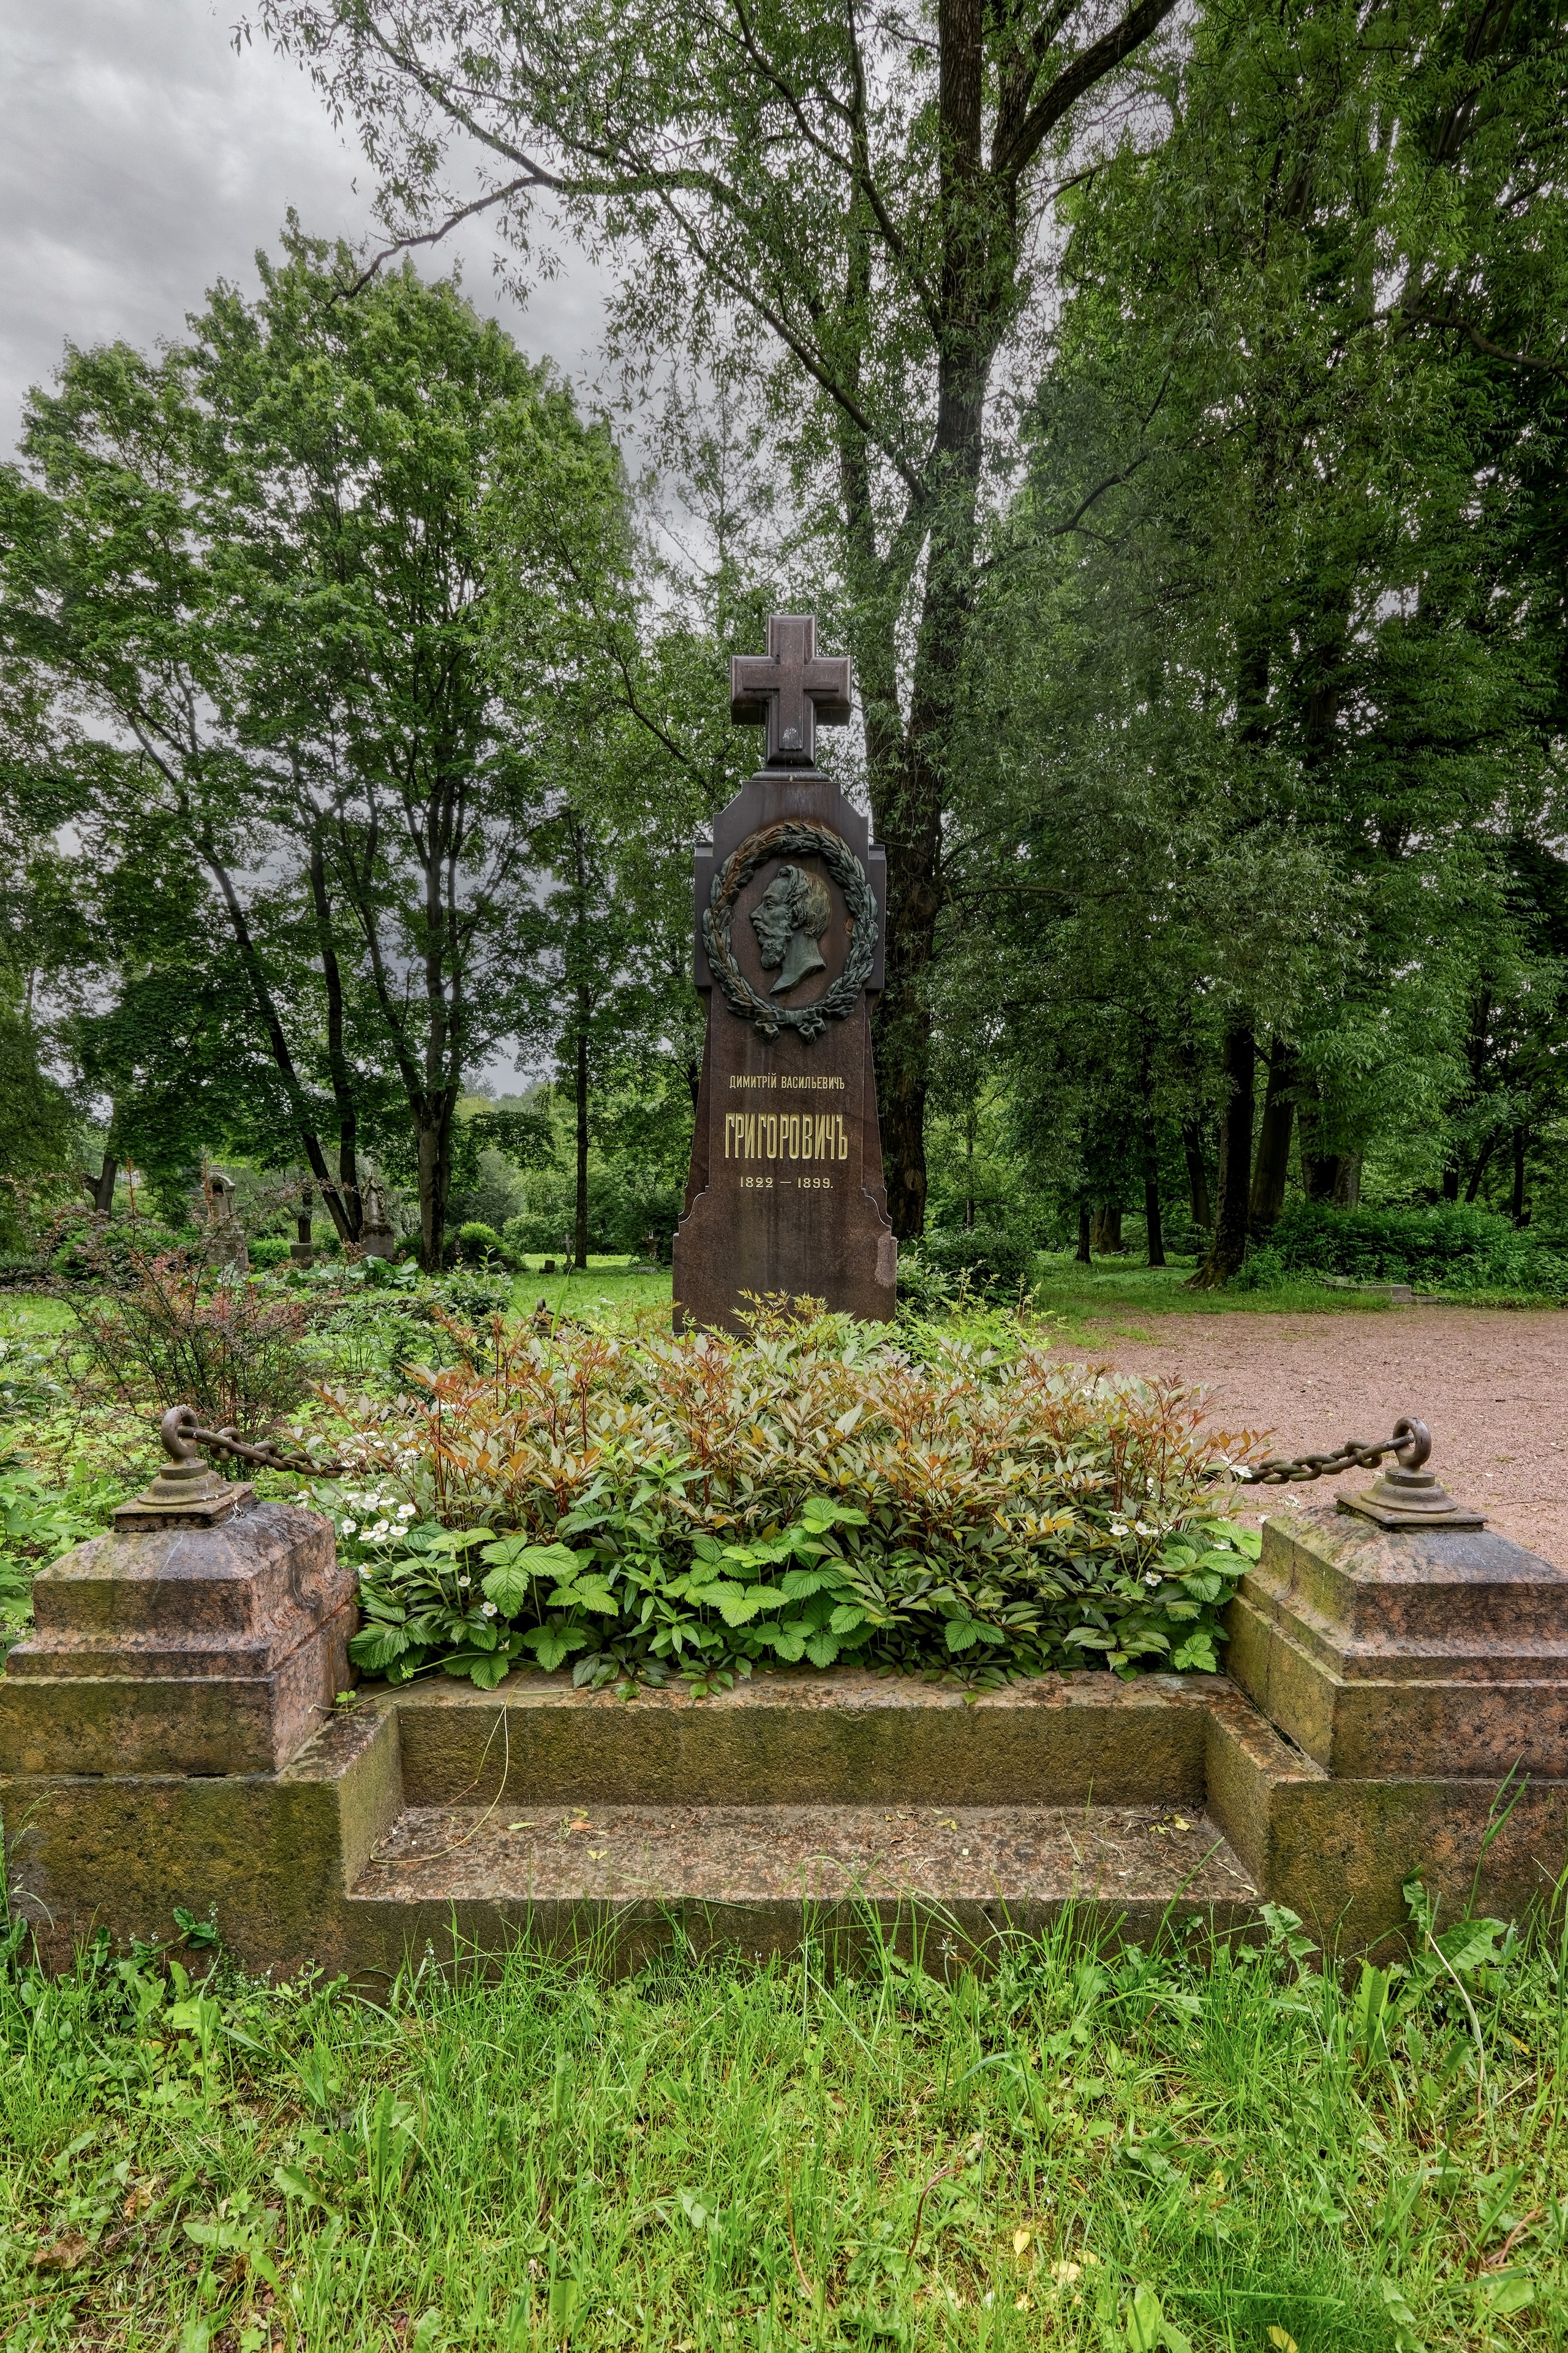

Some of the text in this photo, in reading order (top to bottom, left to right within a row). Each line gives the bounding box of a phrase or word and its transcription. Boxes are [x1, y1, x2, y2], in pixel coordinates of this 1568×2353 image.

[729, 1073, 845, 1089] ДИМИТРІЙ ВАСИЛЬЕВИЧЪ
[725, 1113, 848, 1160] ГРИГОРОВИЧЪ
[740, 1176, 774, 1188] 1822
[797, 1177, 834, 1188] 1899.
